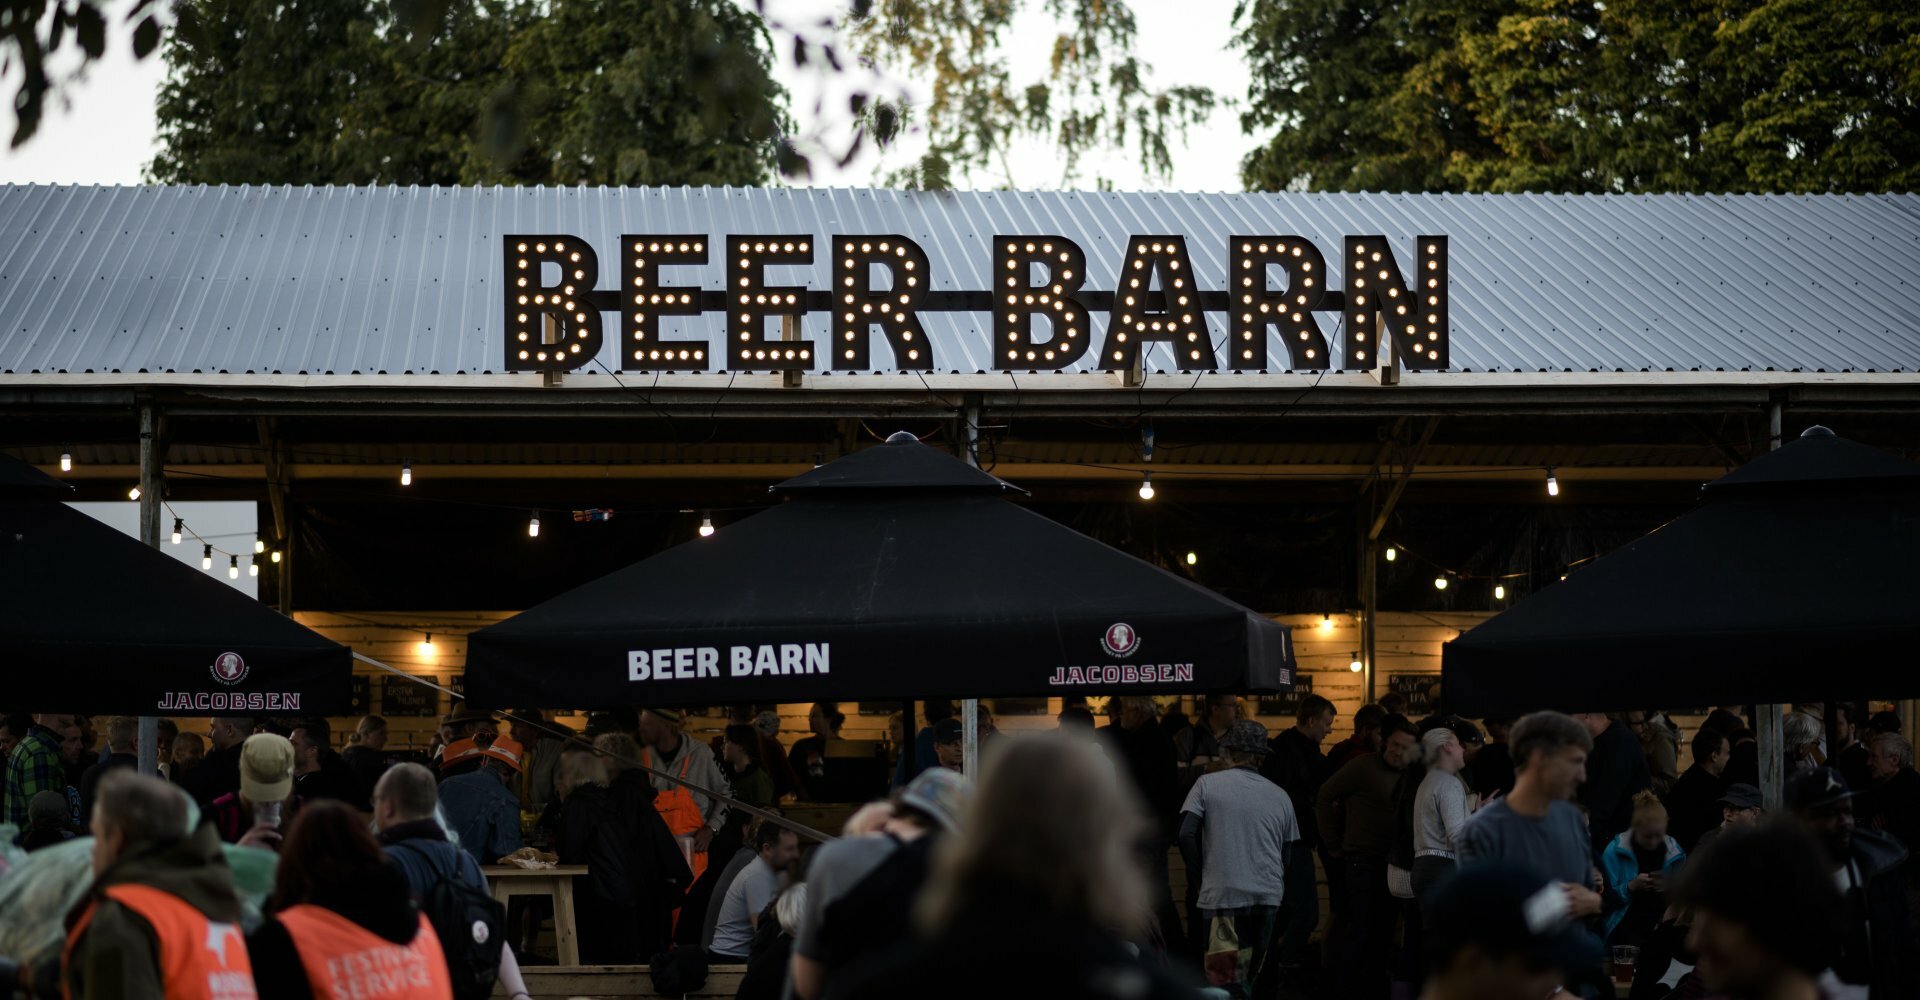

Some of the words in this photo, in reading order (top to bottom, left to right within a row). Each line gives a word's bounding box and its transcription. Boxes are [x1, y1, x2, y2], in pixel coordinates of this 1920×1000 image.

[503, 234, 934, 371] BEER
[992, 234, 1450, 371] BARN
[628, 647, 720, 681] BEER
[730, 642, 830, 677] BARN
[1049, 663, 1194, 685] JACOBSEN
[157, 692, 301, 710] JACOBSEN
[330, 961, 433, 1000] SERVICE
